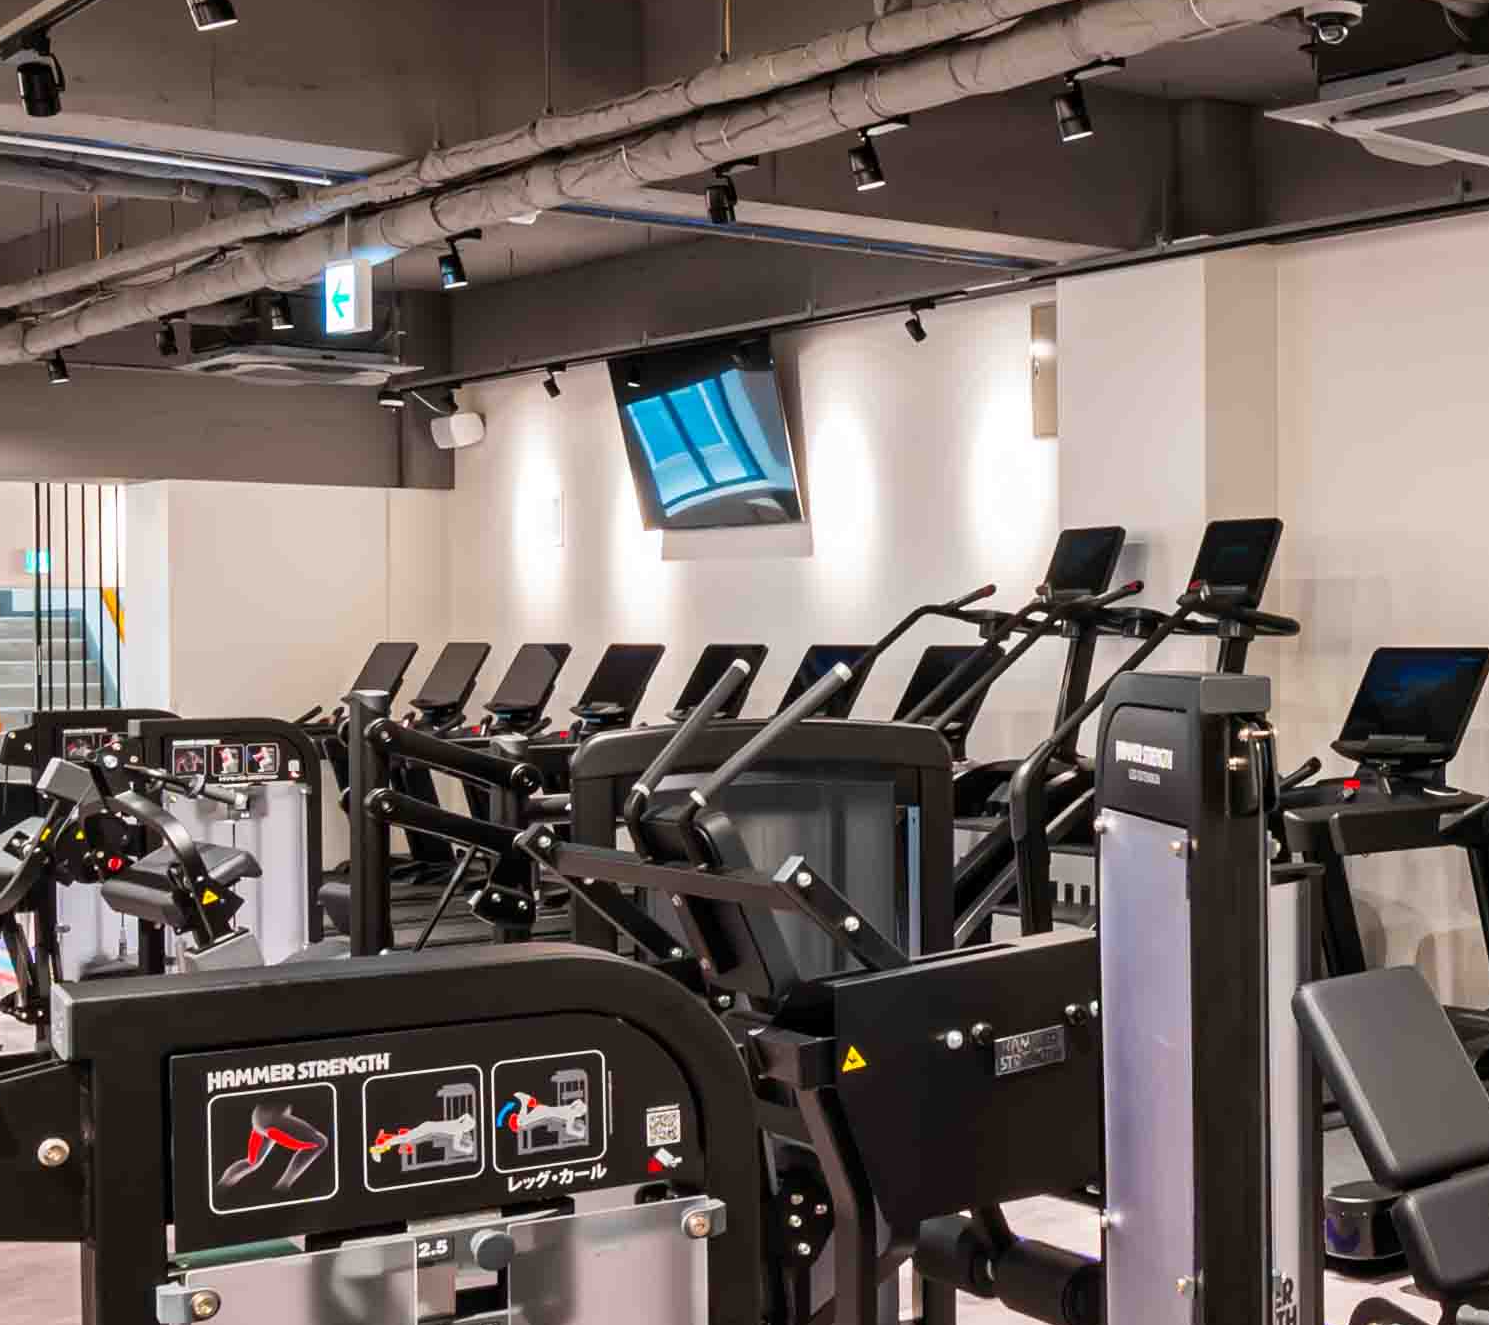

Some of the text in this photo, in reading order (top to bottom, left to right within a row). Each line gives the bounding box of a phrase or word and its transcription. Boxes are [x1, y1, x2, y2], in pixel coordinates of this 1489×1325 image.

[207, 1052, 391, 1094] HAMMER STRENGTH
[507, 1163, 608, 1193] レッグ・カール
[417, 1238, 449, 1258] 2.5
